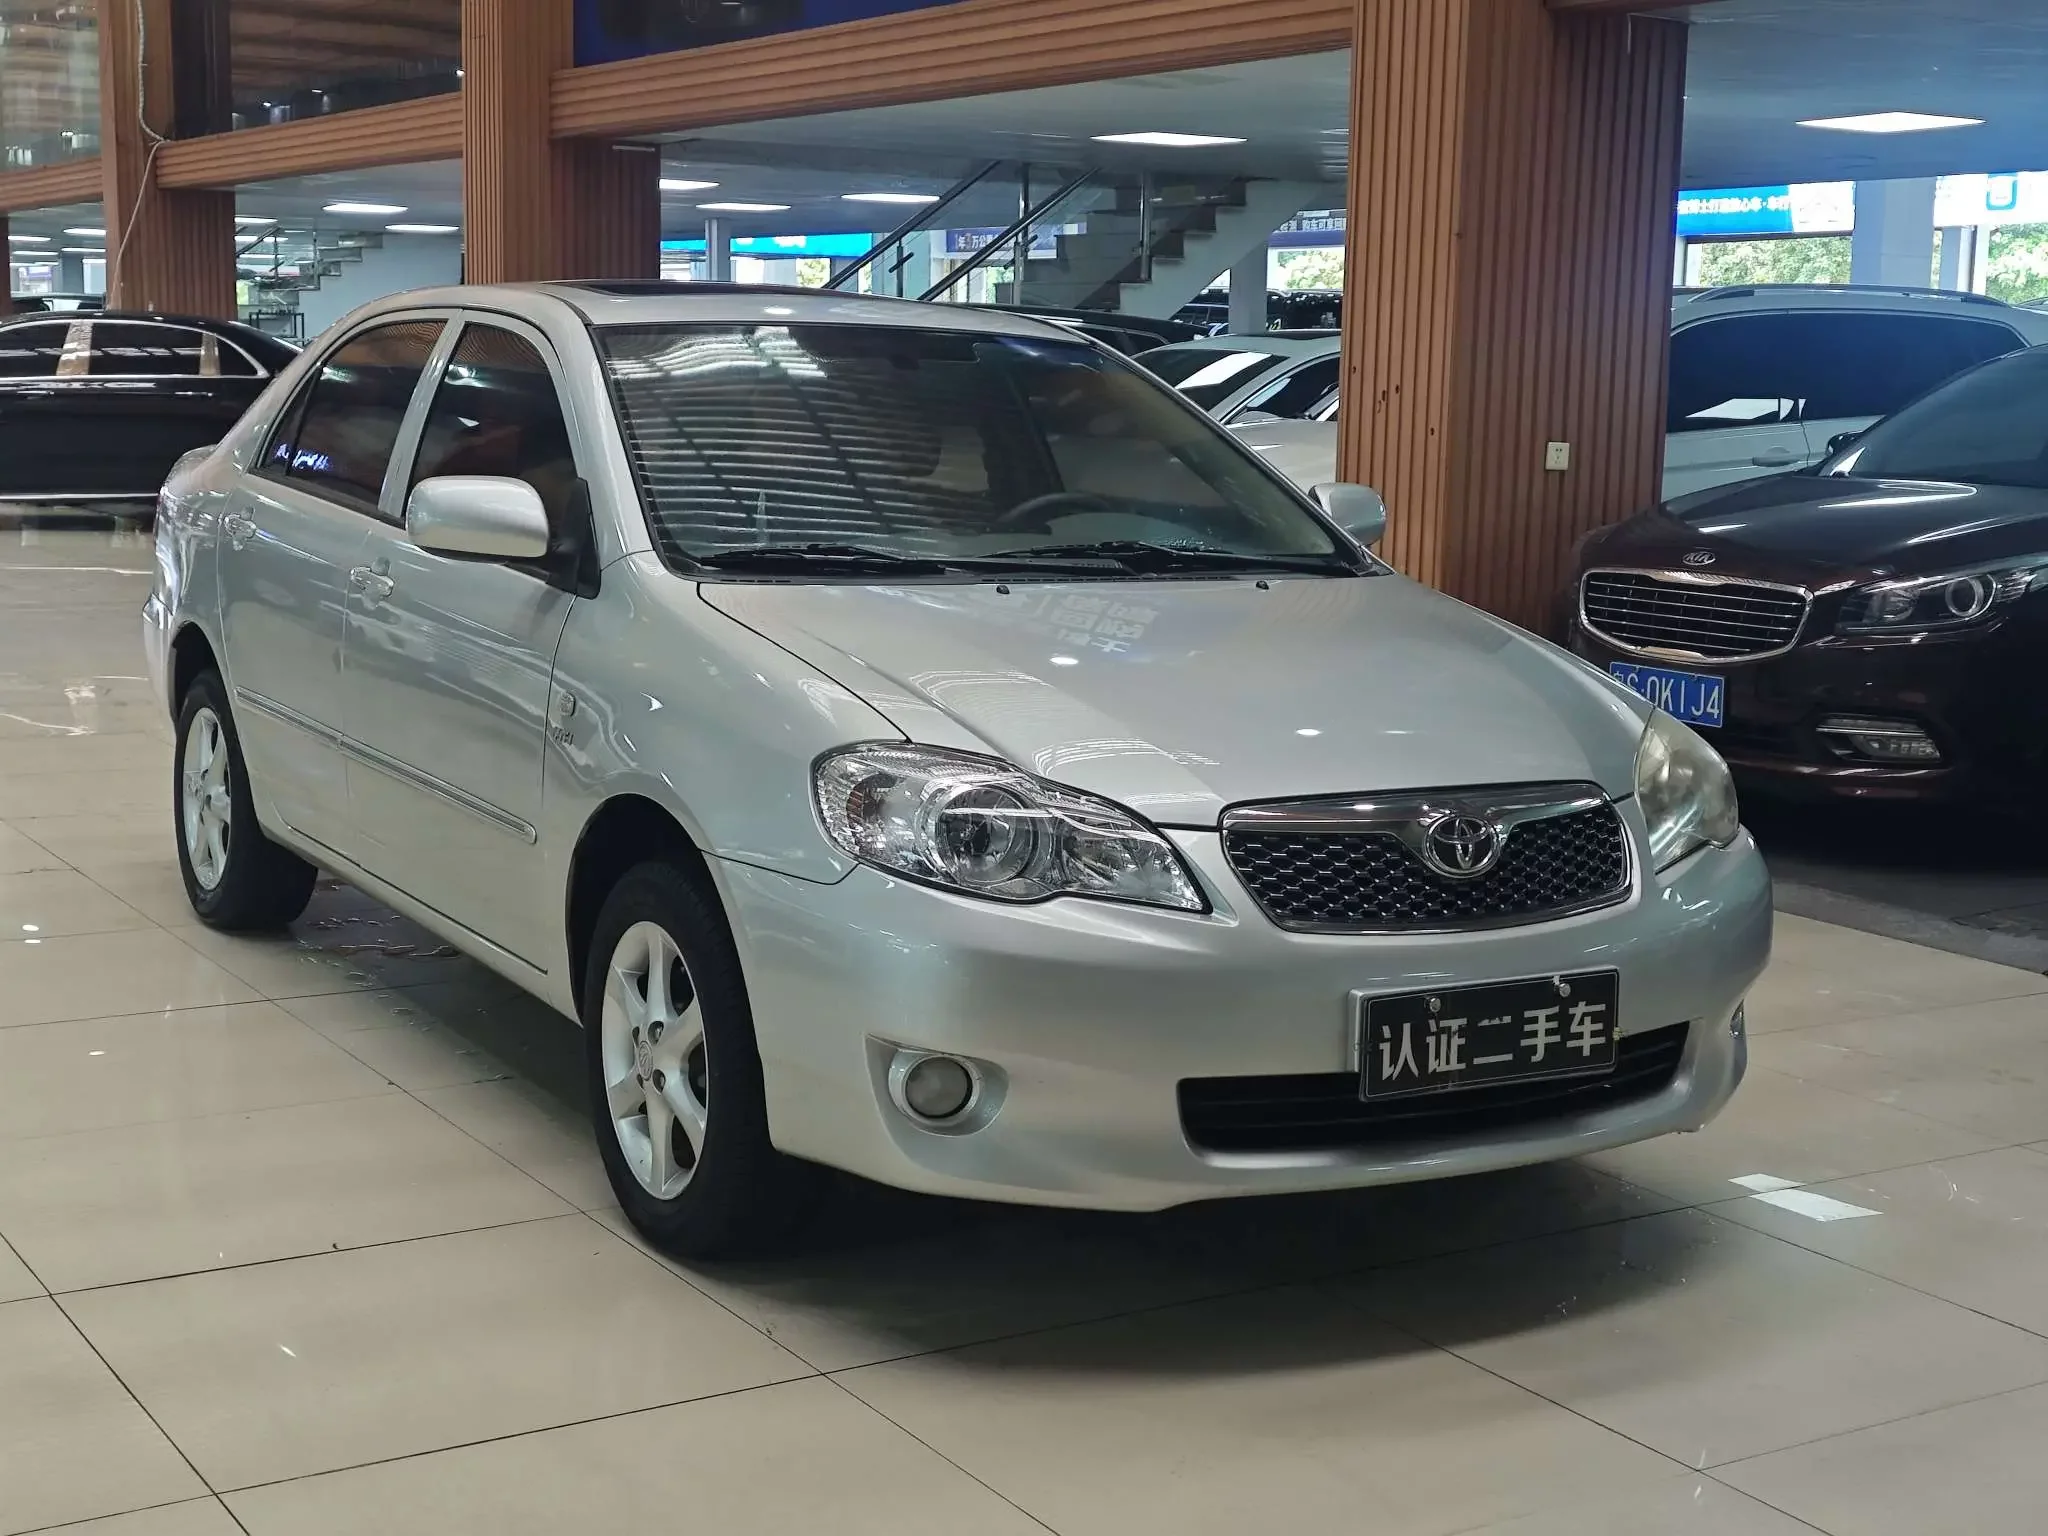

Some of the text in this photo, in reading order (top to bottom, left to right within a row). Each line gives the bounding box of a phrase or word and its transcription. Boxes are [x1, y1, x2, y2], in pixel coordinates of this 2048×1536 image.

[1379, 1001, 1606, 1080] 认证二手车
